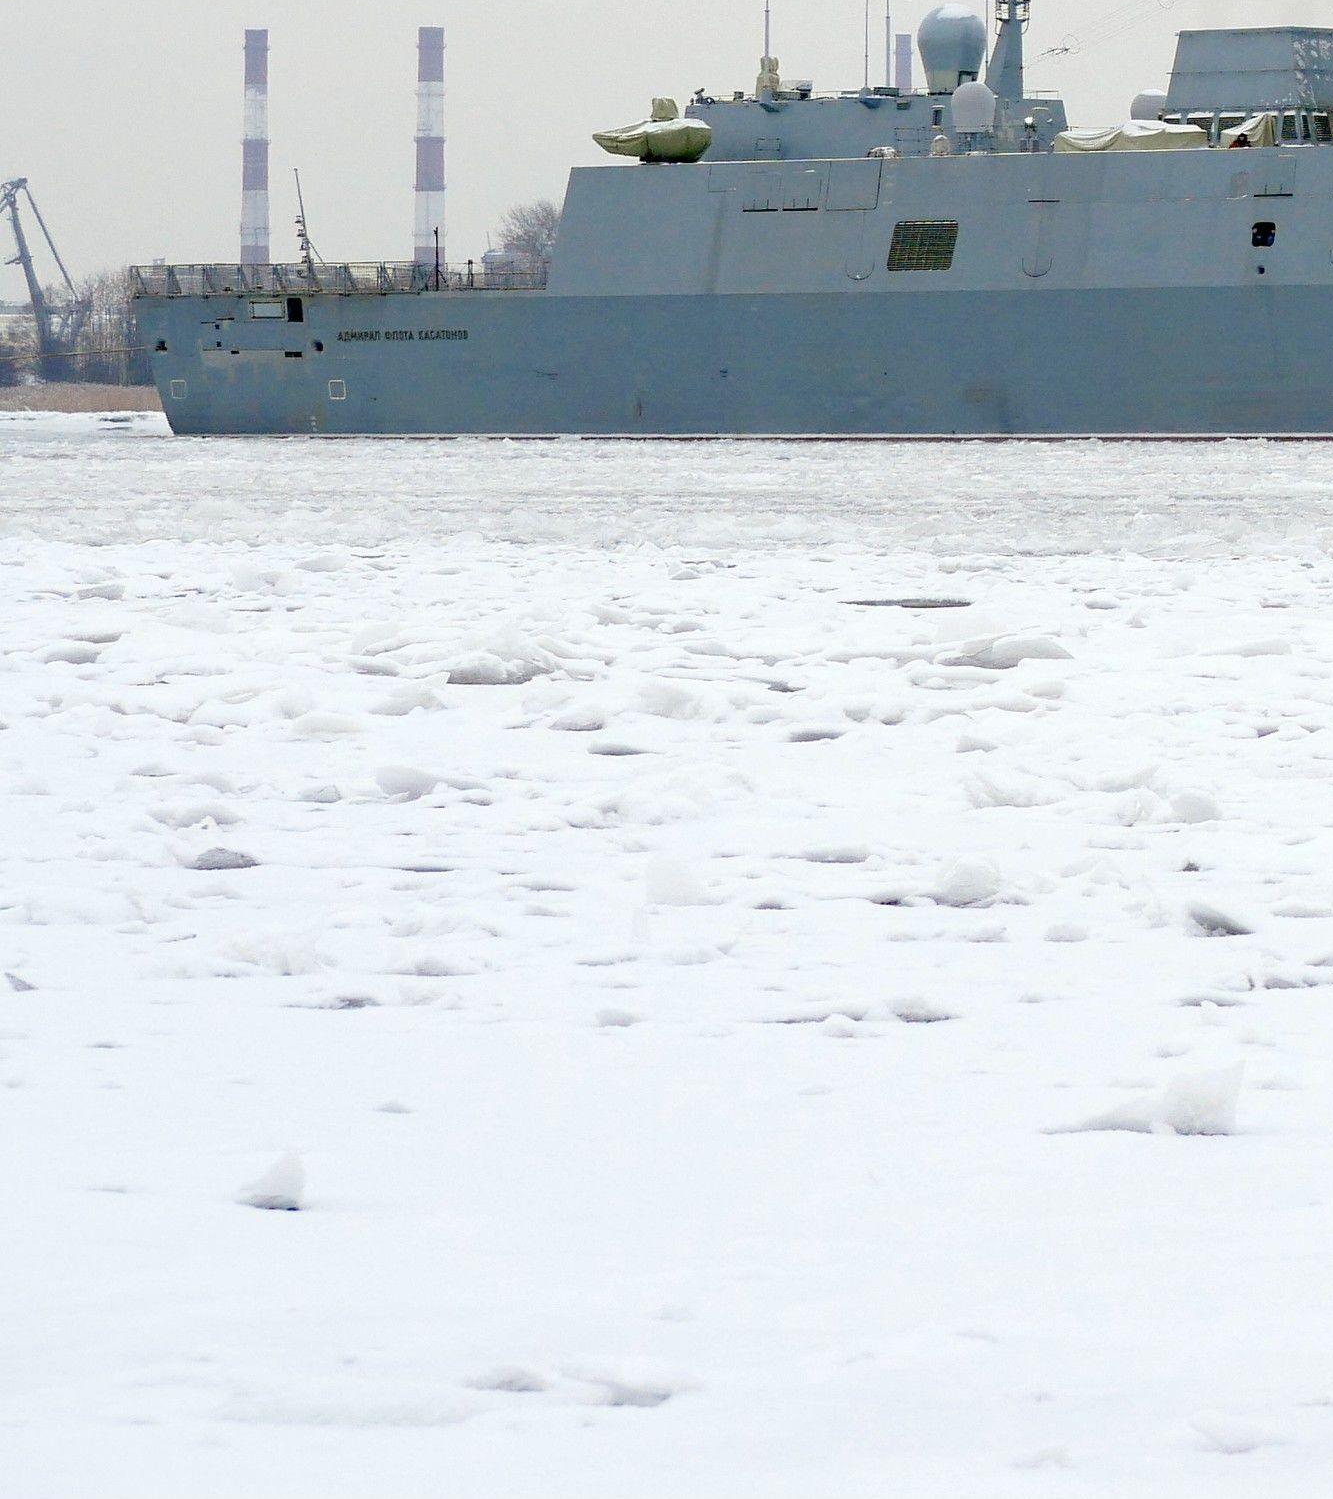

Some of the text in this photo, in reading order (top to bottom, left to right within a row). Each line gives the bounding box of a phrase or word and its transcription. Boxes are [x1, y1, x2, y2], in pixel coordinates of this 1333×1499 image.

[337, 329, 469, 342] АДМИРАЛ ФЛОТА КАСАТОНОВ
